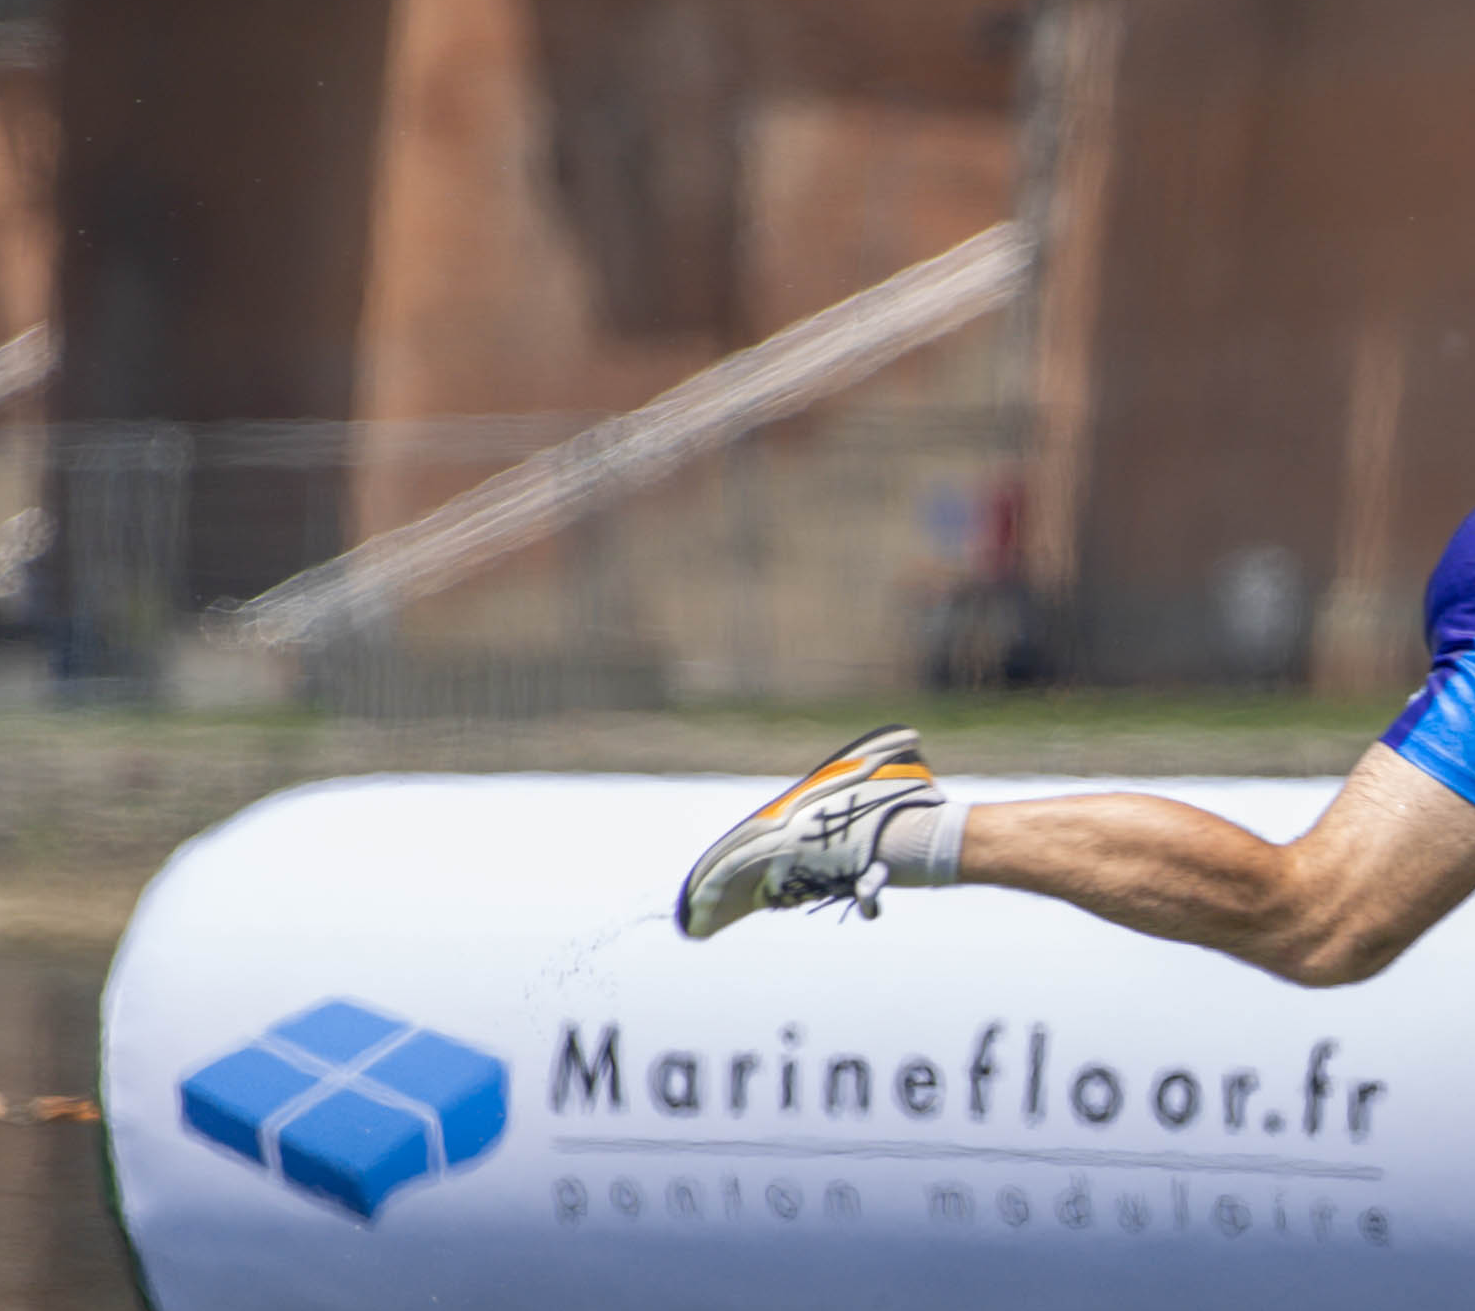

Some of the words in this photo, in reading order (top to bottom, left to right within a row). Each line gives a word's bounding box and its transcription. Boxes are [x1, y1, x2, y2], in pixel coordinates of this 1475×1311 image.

[549, 1021, 1391, 1143] Marinefloor.fr
[549, 1172, 862, 1227] ponton
[931, 1172, 1393, 1249] modulaire
